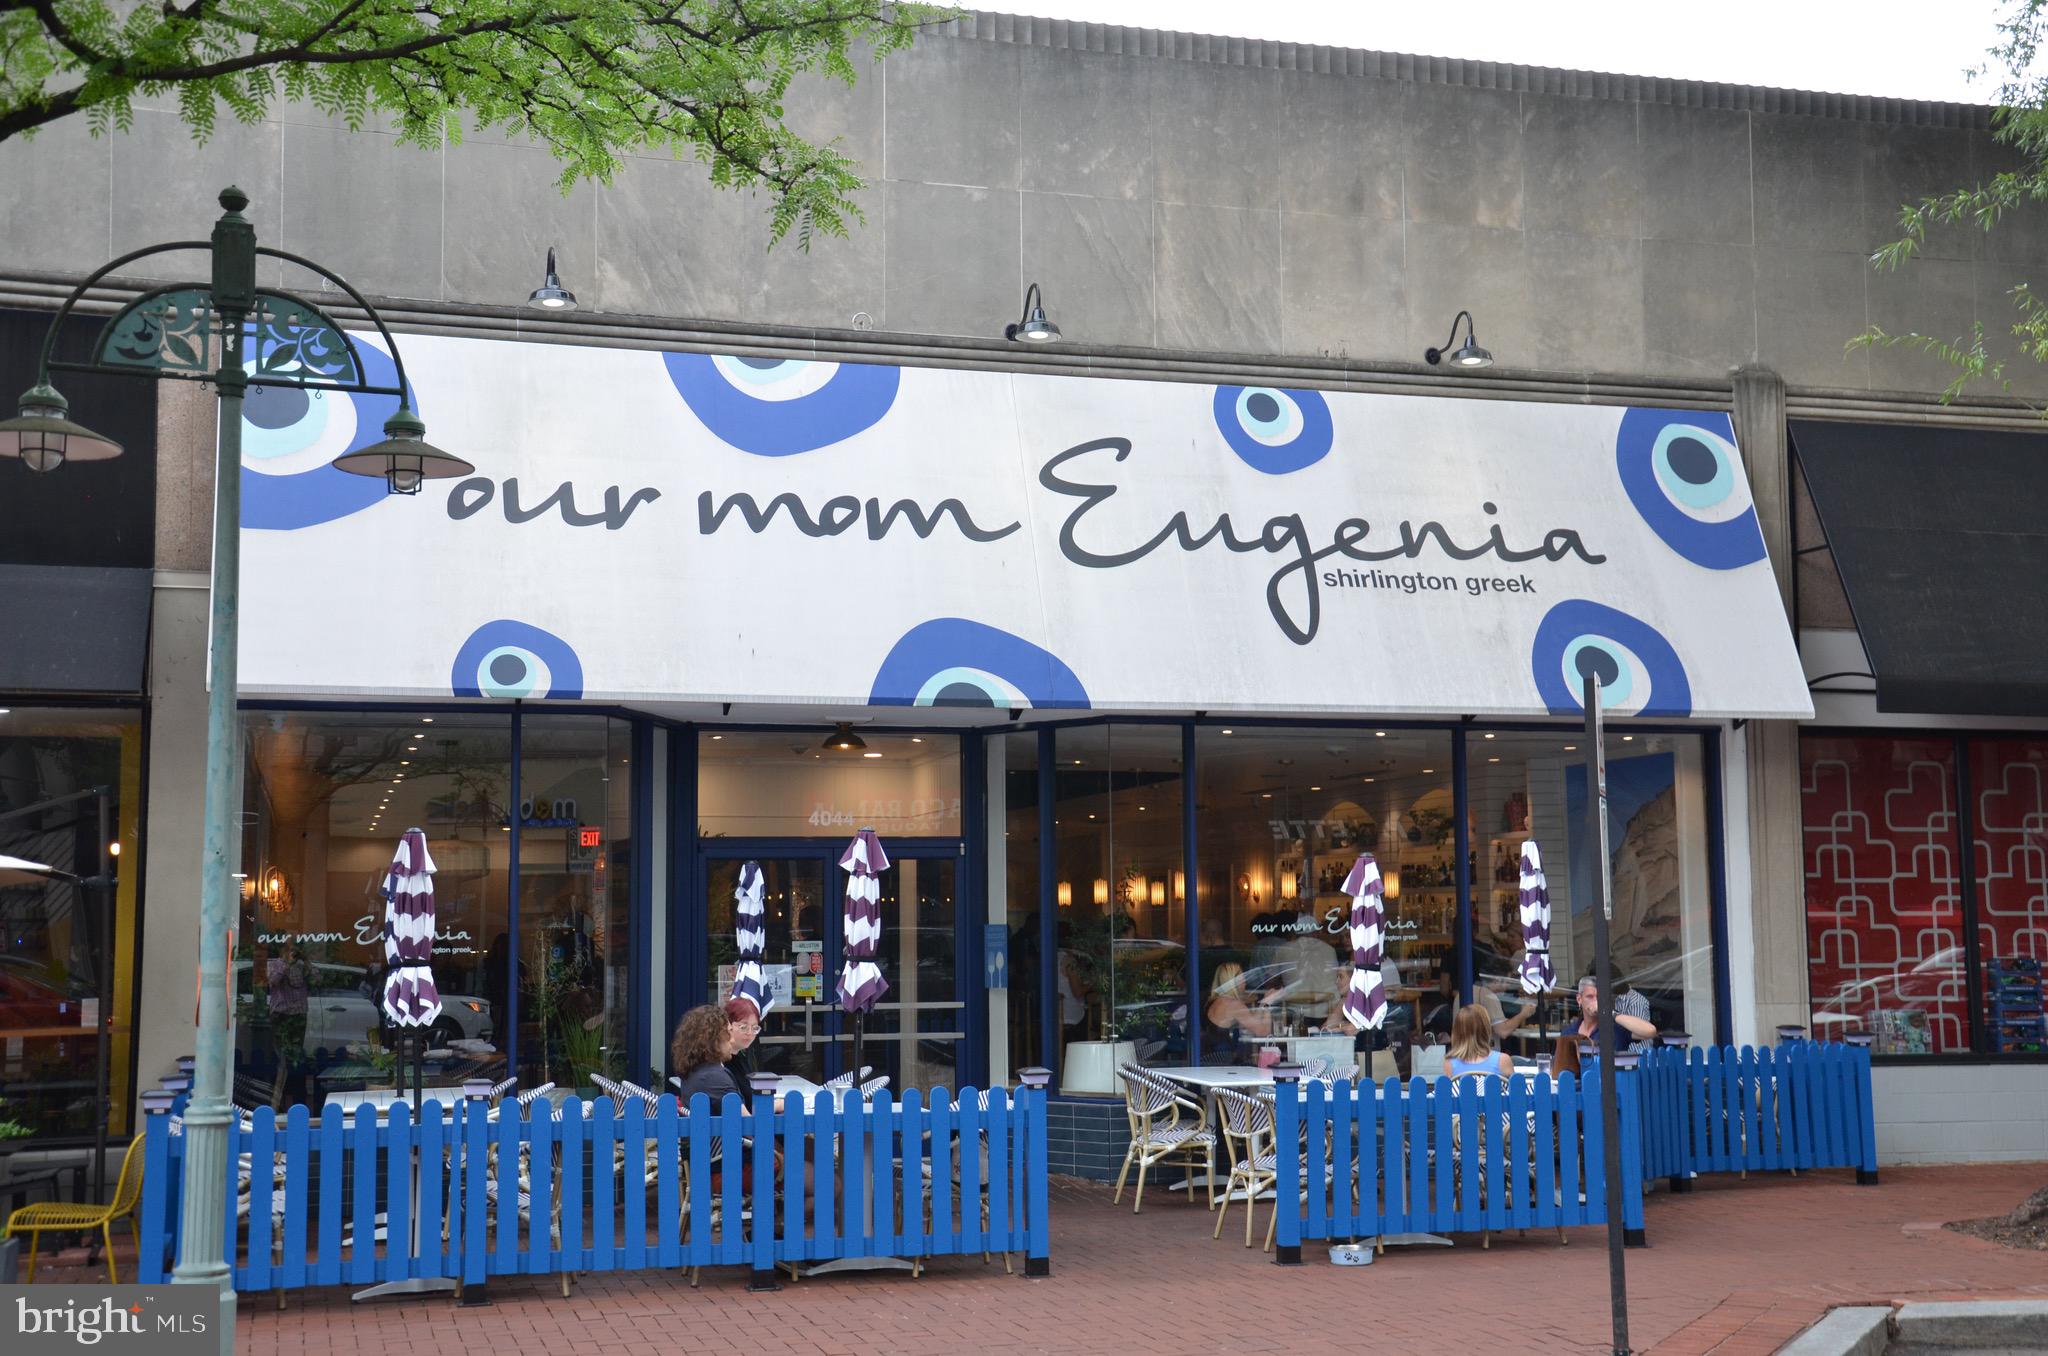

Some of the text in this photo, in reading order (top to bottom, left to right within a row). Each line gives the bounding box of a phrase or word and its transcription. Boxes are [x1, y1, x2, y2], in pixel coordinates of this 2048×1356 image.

[447, 437, 1606, 645] our mom Eugenia
[1323, 569, 1537, 596] shirlington greek
[808, 810, 855, 827] 4044
[580, 831, 600, 847] EXIT
[1252, 924, 1278, 933] our
[1281, 922, 1323, 933] mom
[257, 933, 291, 943] our
[296, 932, 351, 943] mom
[452, 946, 471, 955] greek
